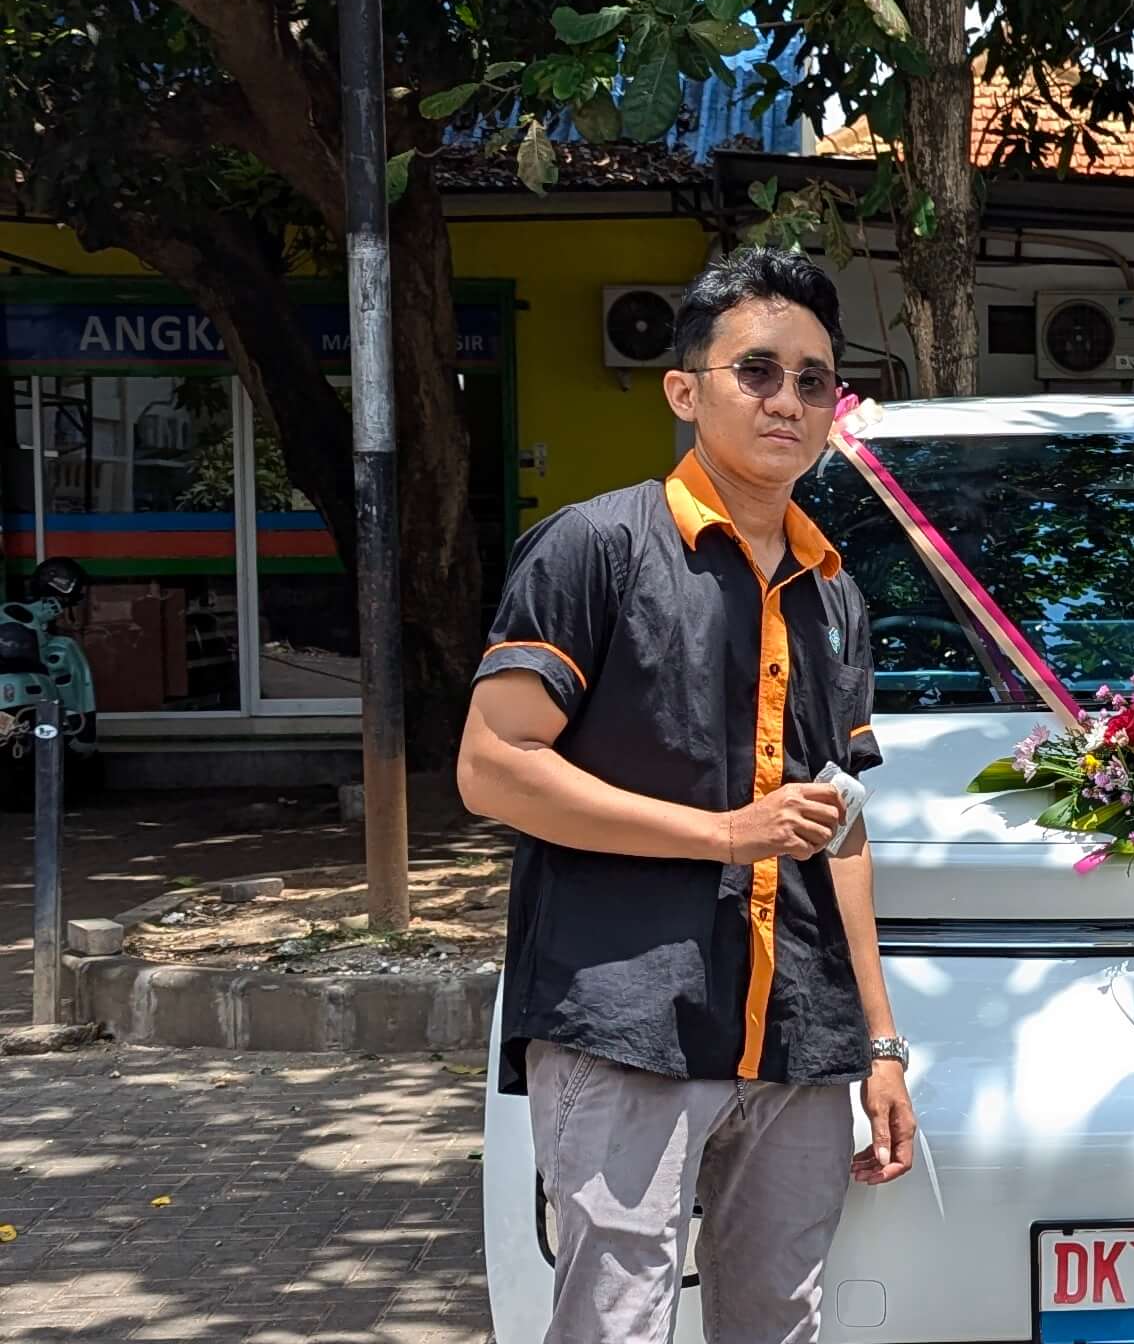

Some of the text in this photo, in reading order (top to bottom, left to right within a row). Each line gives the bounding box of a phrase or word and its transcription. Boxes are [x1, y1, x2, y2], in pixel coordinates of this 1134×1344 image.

[80, 315, 224, 352] ANGK
[455, 335, 484, 351] SIR
[1053, 1240, 1127, 1304] DK
